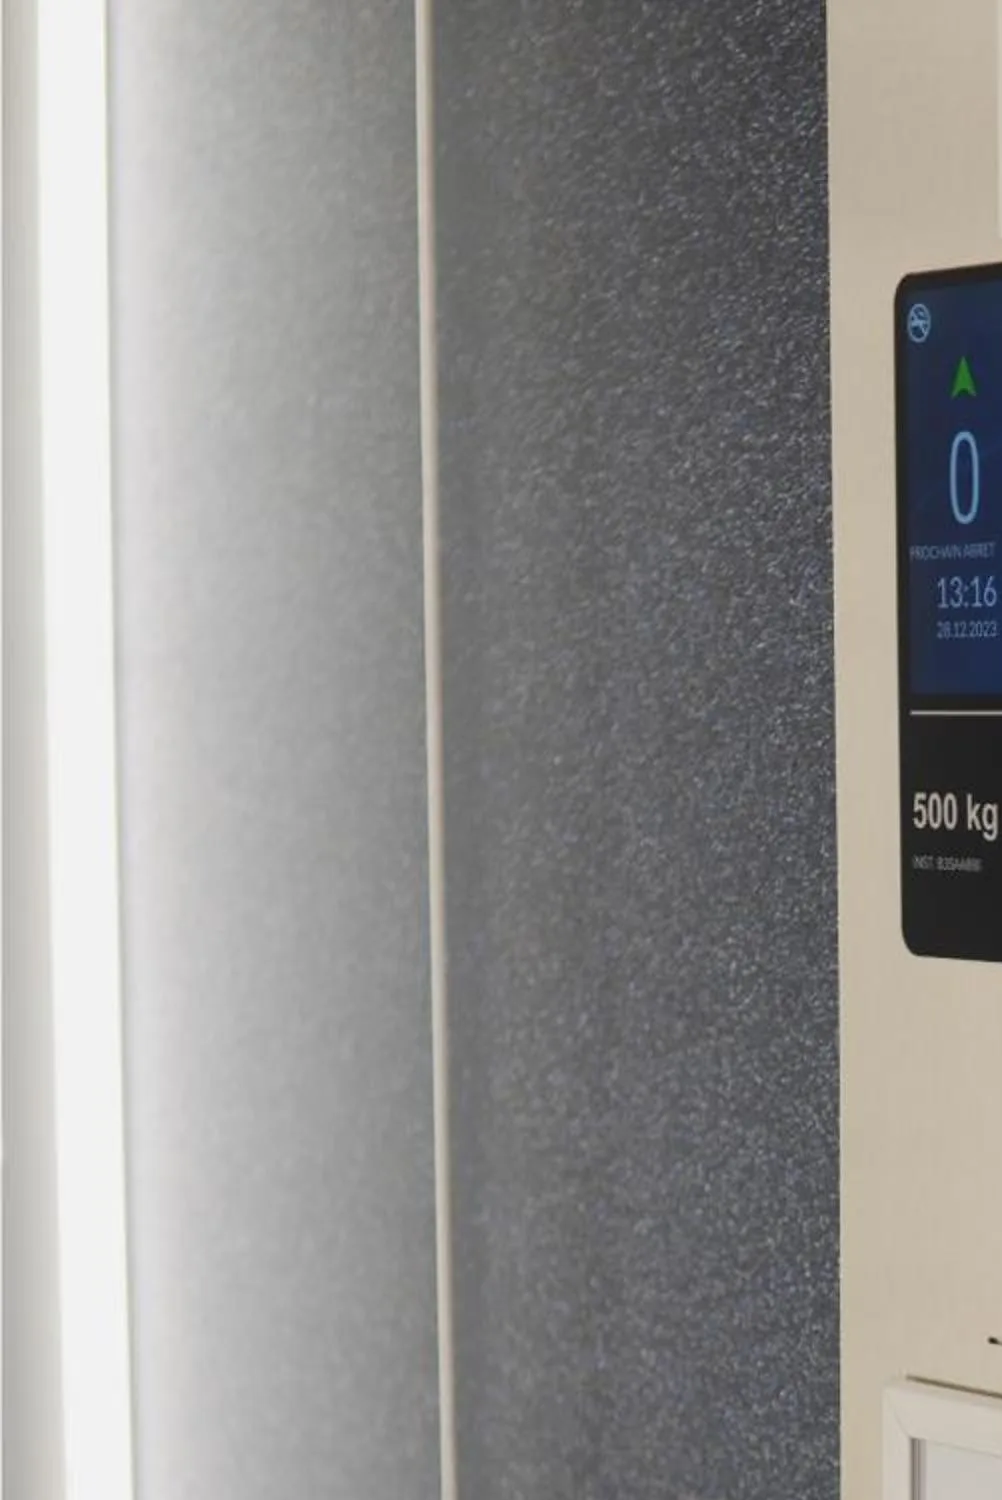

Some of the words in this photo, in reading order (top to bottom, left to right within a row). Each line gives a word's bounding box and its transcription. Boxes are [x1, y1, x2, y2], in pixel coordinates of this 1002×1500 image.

[950, 430, 980, 525] 0
[937, 575, 997, 608] 13:16
[912, 791, 958, 831] 500
[966, 792, 999, 842] kg
